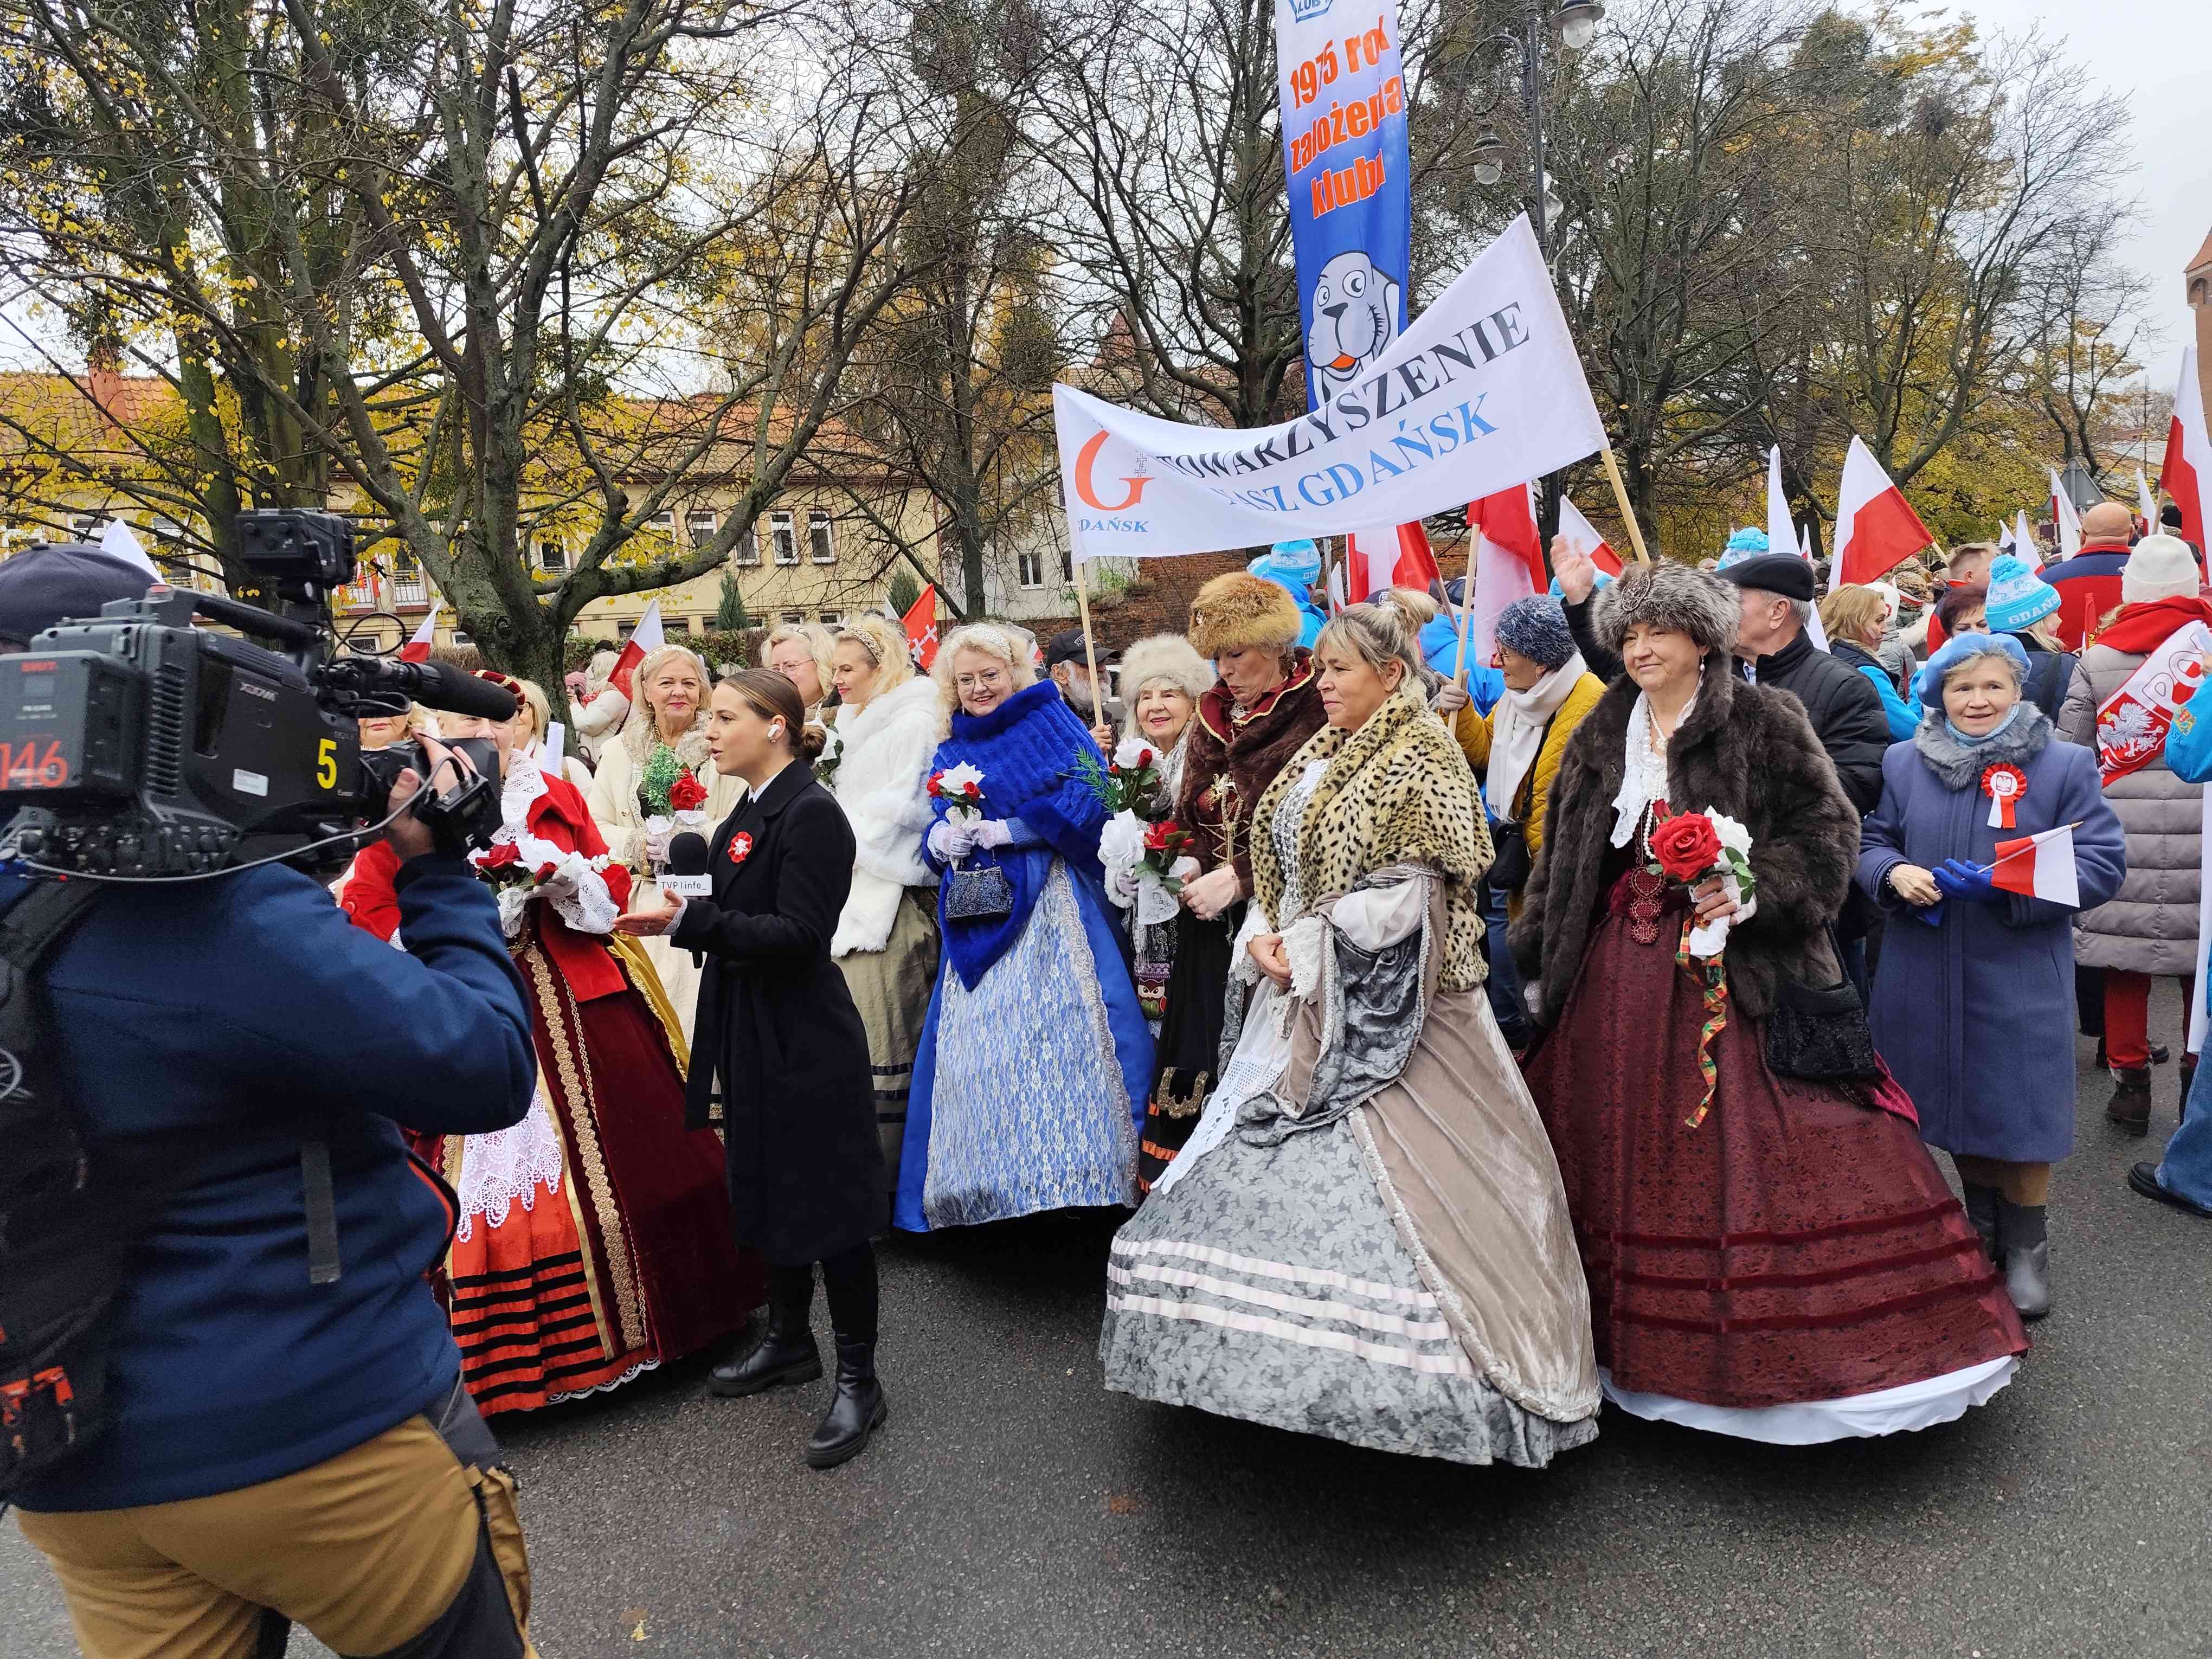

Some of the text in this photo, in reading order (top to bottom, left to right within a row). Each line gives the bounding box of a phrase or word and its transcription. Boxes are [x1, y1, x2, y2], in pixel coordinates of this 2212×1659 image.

[1147, 301, 1530, 478] TOWARZYSZENIE
[1297, 391, 1500, 506] GDAŃSK
[1078, 517, 1150, 533] DAŃSK
[316, 738, 337, 789] 5
